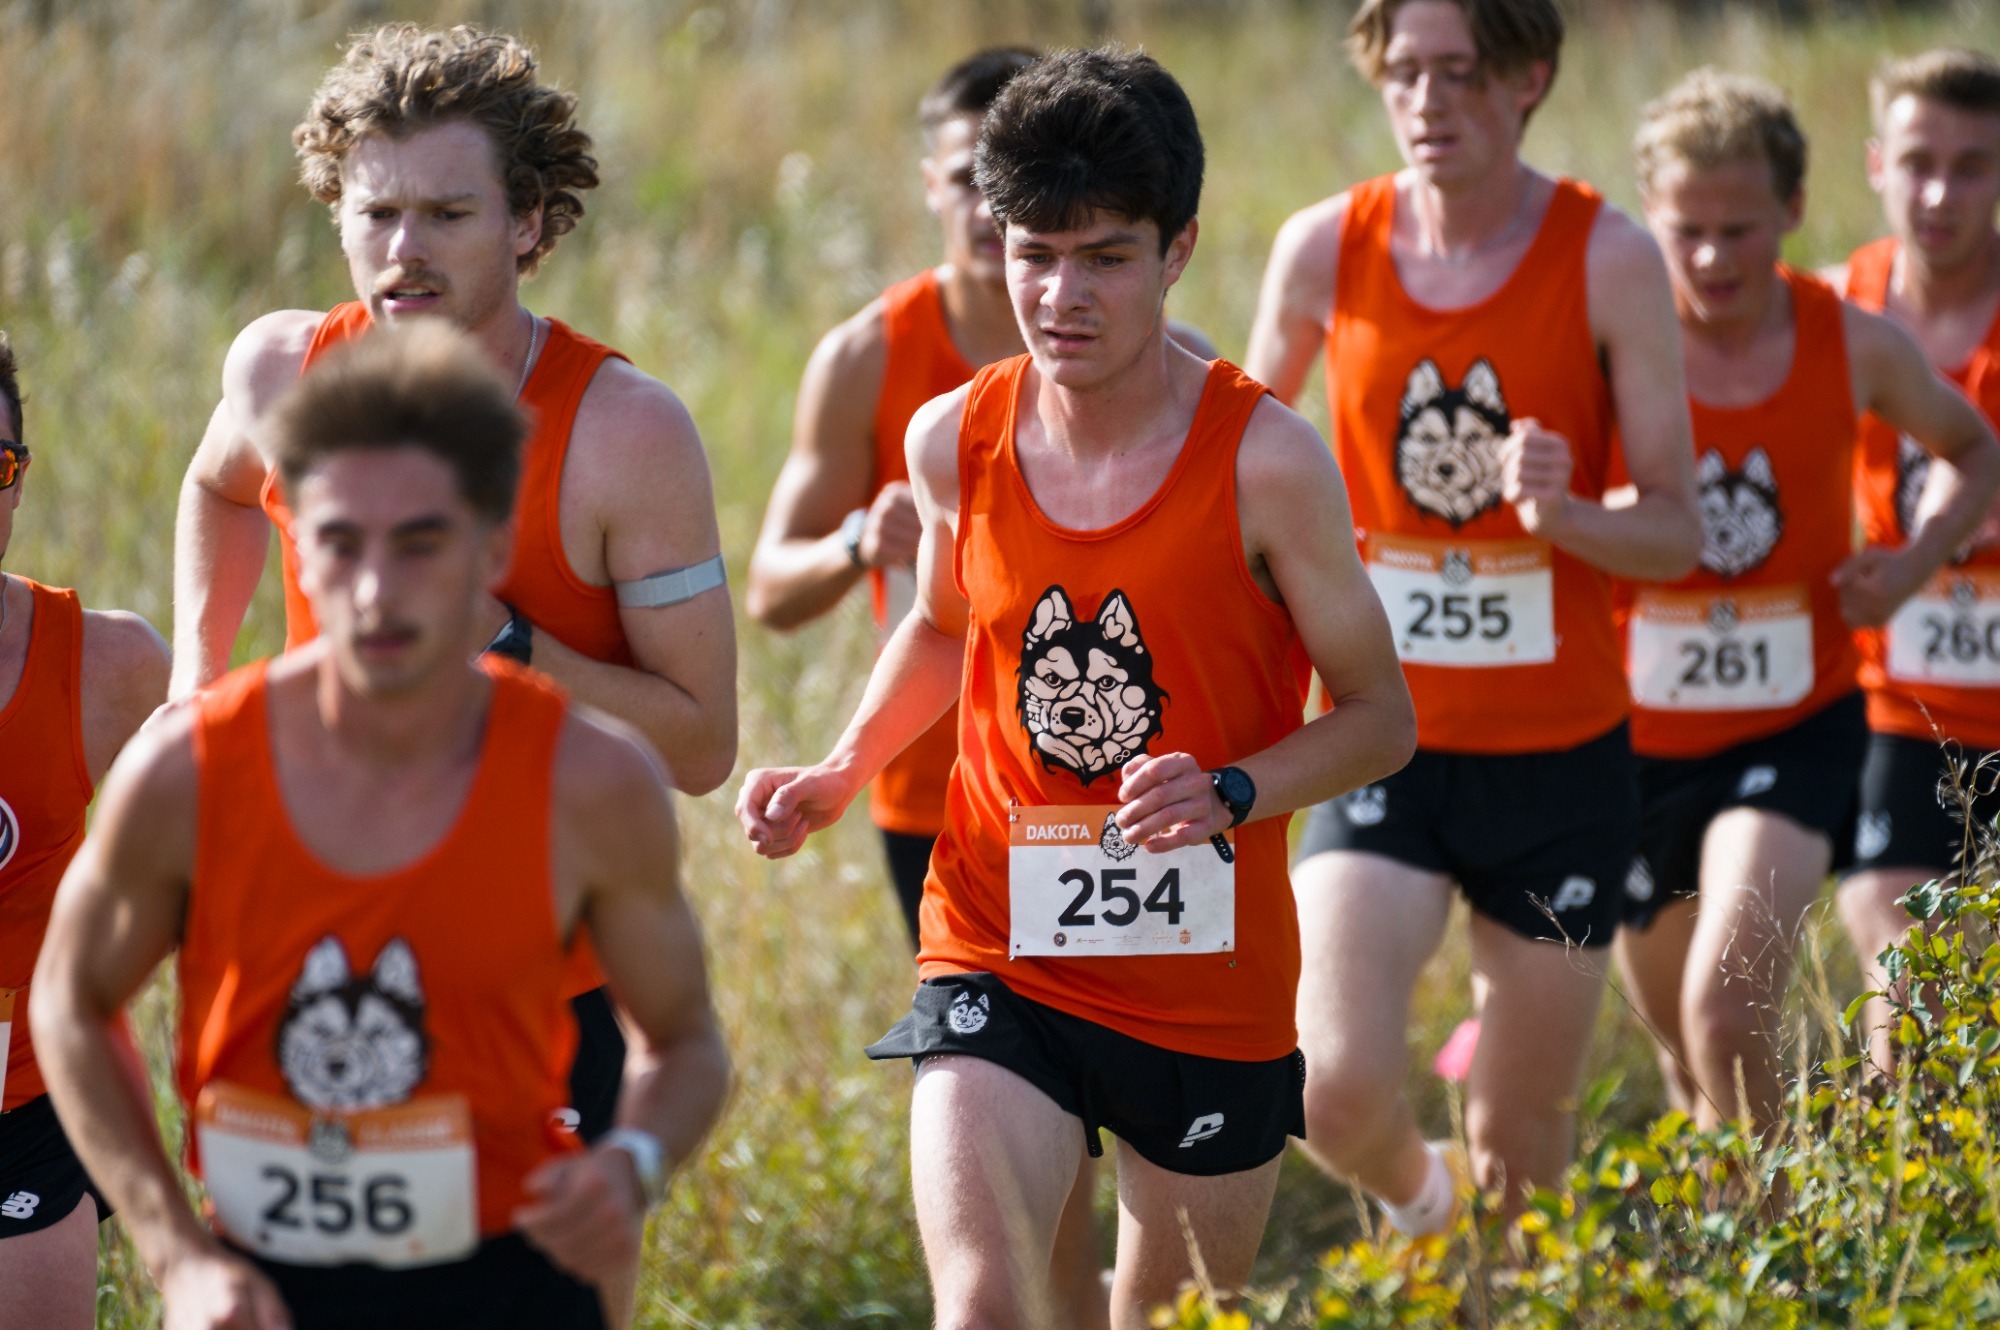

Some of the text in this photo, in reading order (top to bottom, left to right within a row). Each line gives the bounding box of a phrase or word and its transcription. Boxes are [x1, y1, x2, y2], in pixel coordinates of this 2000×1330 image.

[1407, 591, 1512, 640] 255
[1680, 636, 1769, 687] 261
[1026, 824, 1091, 840] DAKOTA
[1057, 868, 1185, 927] 254
[260, 1164, 415, 1236] 256
